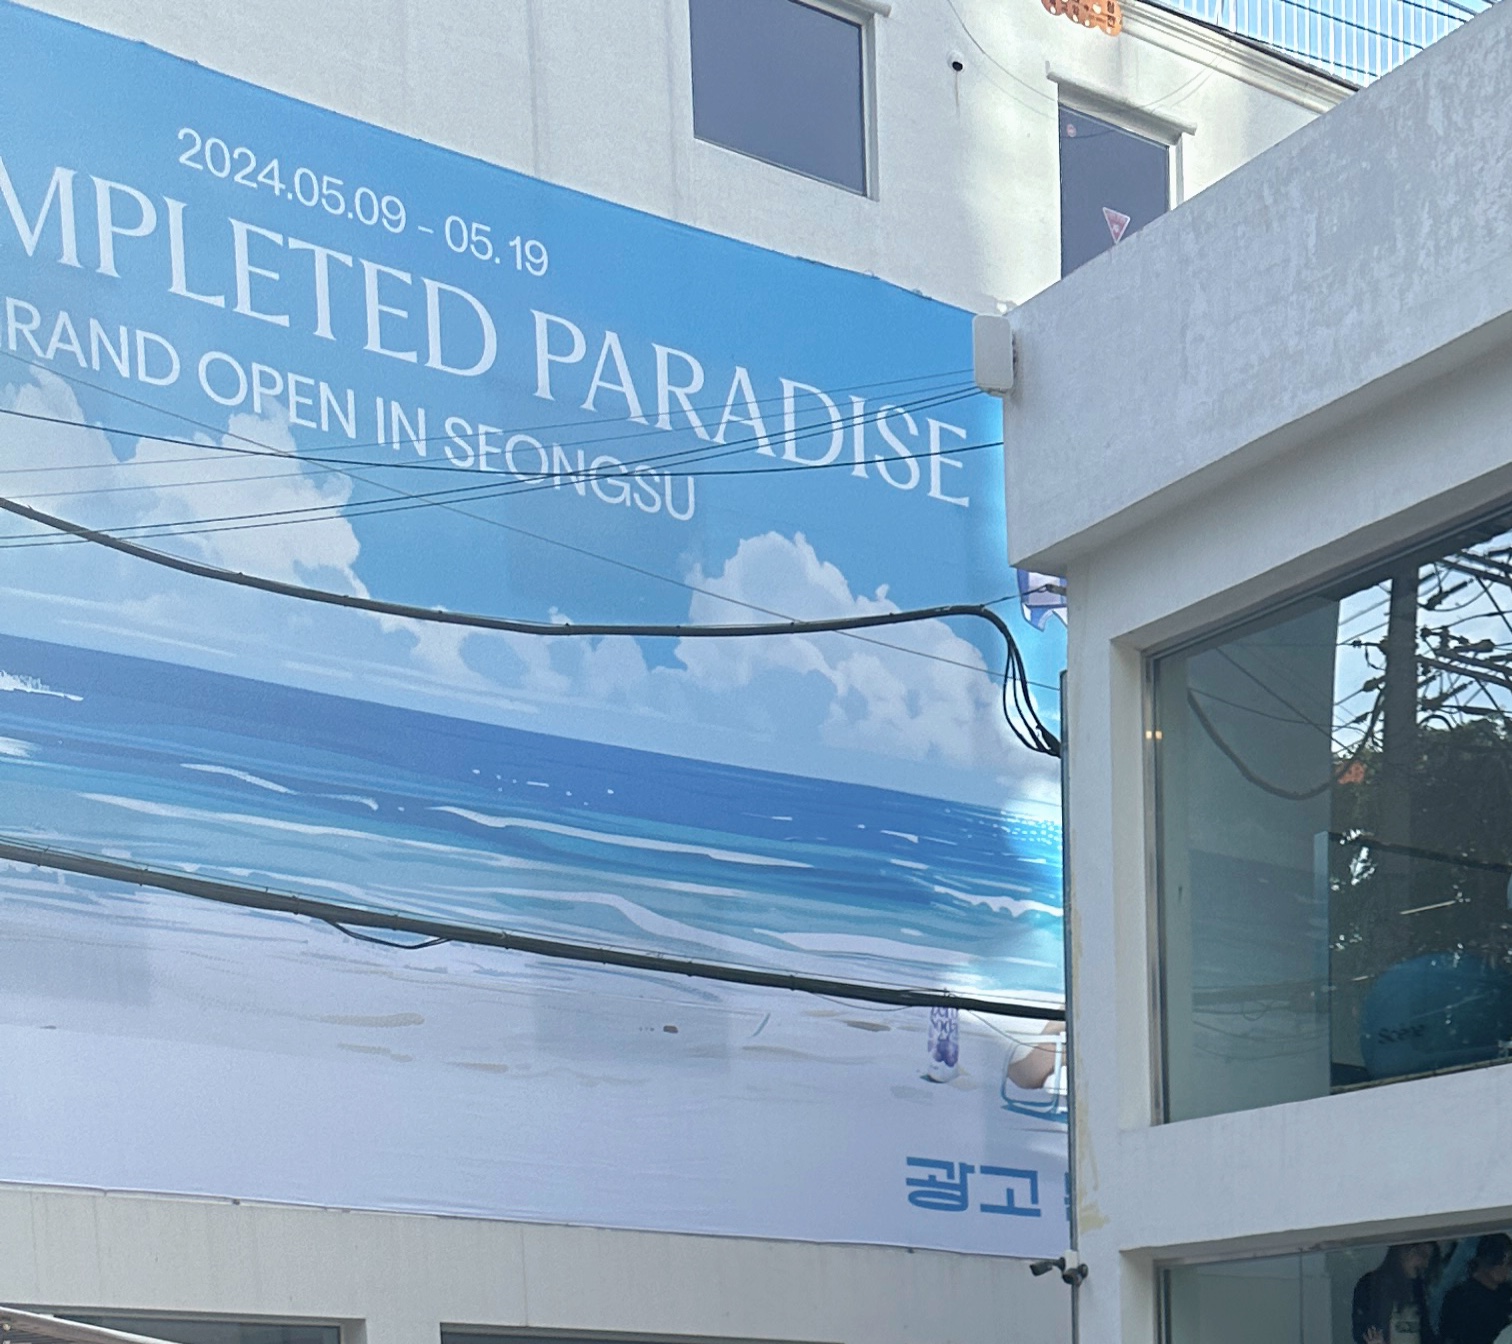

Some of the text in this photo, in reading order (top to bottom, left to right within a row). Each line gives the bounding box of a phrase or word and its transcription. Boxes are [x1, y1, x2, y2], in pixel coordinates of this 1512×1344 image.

[177, 127, 406, 233] 2024.05.09
[444, 215, 549, 277] 05.19
[5, 296, 696, 522] RAND OPEN IN SEONGSU
[530, 308, 970, 508] PARADISE
[905, 1156, 1042, 1218] 광고
